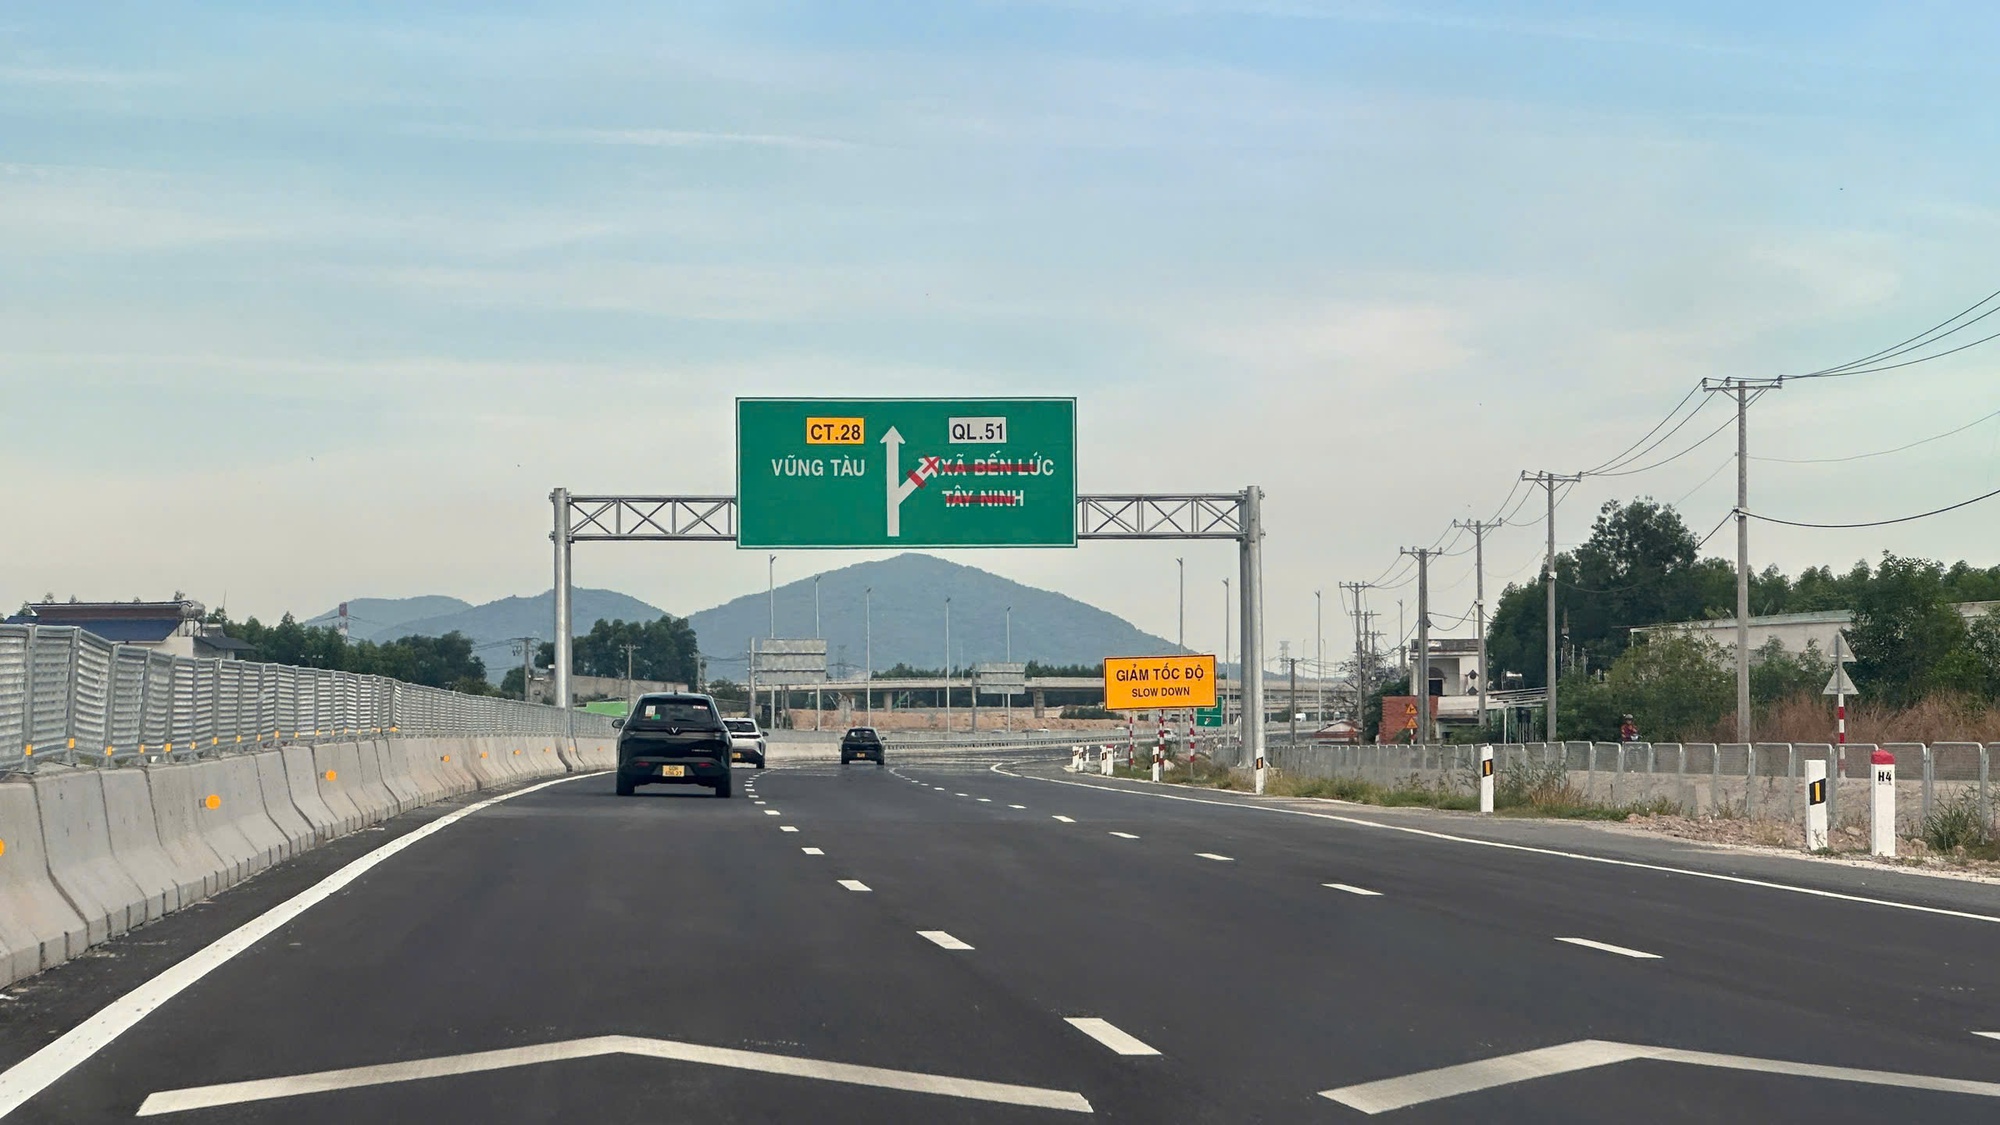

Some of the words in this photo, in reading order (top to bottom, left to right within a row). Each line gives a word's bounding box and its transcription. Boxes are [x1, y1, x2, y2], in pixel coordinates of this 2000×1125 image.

[810, 424, 861, 441] CT.28
[952, 423, 1004, 440] QL.51
[771, 454, 824, 477] VŨNG
[830, 454, 866, 477] TÀU
[941, 453, 967, 476] XÃ
[974, 450, 1012, 476] BẾN
[1018, 451, 1054, 476] LỨC
[942, 484, 974, 507] TÂY
[980, 489, 1024, 507] NINH
[1116, 663, 1149, 682] GIẢM
[1153, 662, 1180, 680] TỐC
[1185, 664, 1204, 681] ĐỘ
[1132, 687, 1158, 697] SLOW
[1161, 686, 1190, 697] DOWN
[1878, 771, 1892, 782] H4
